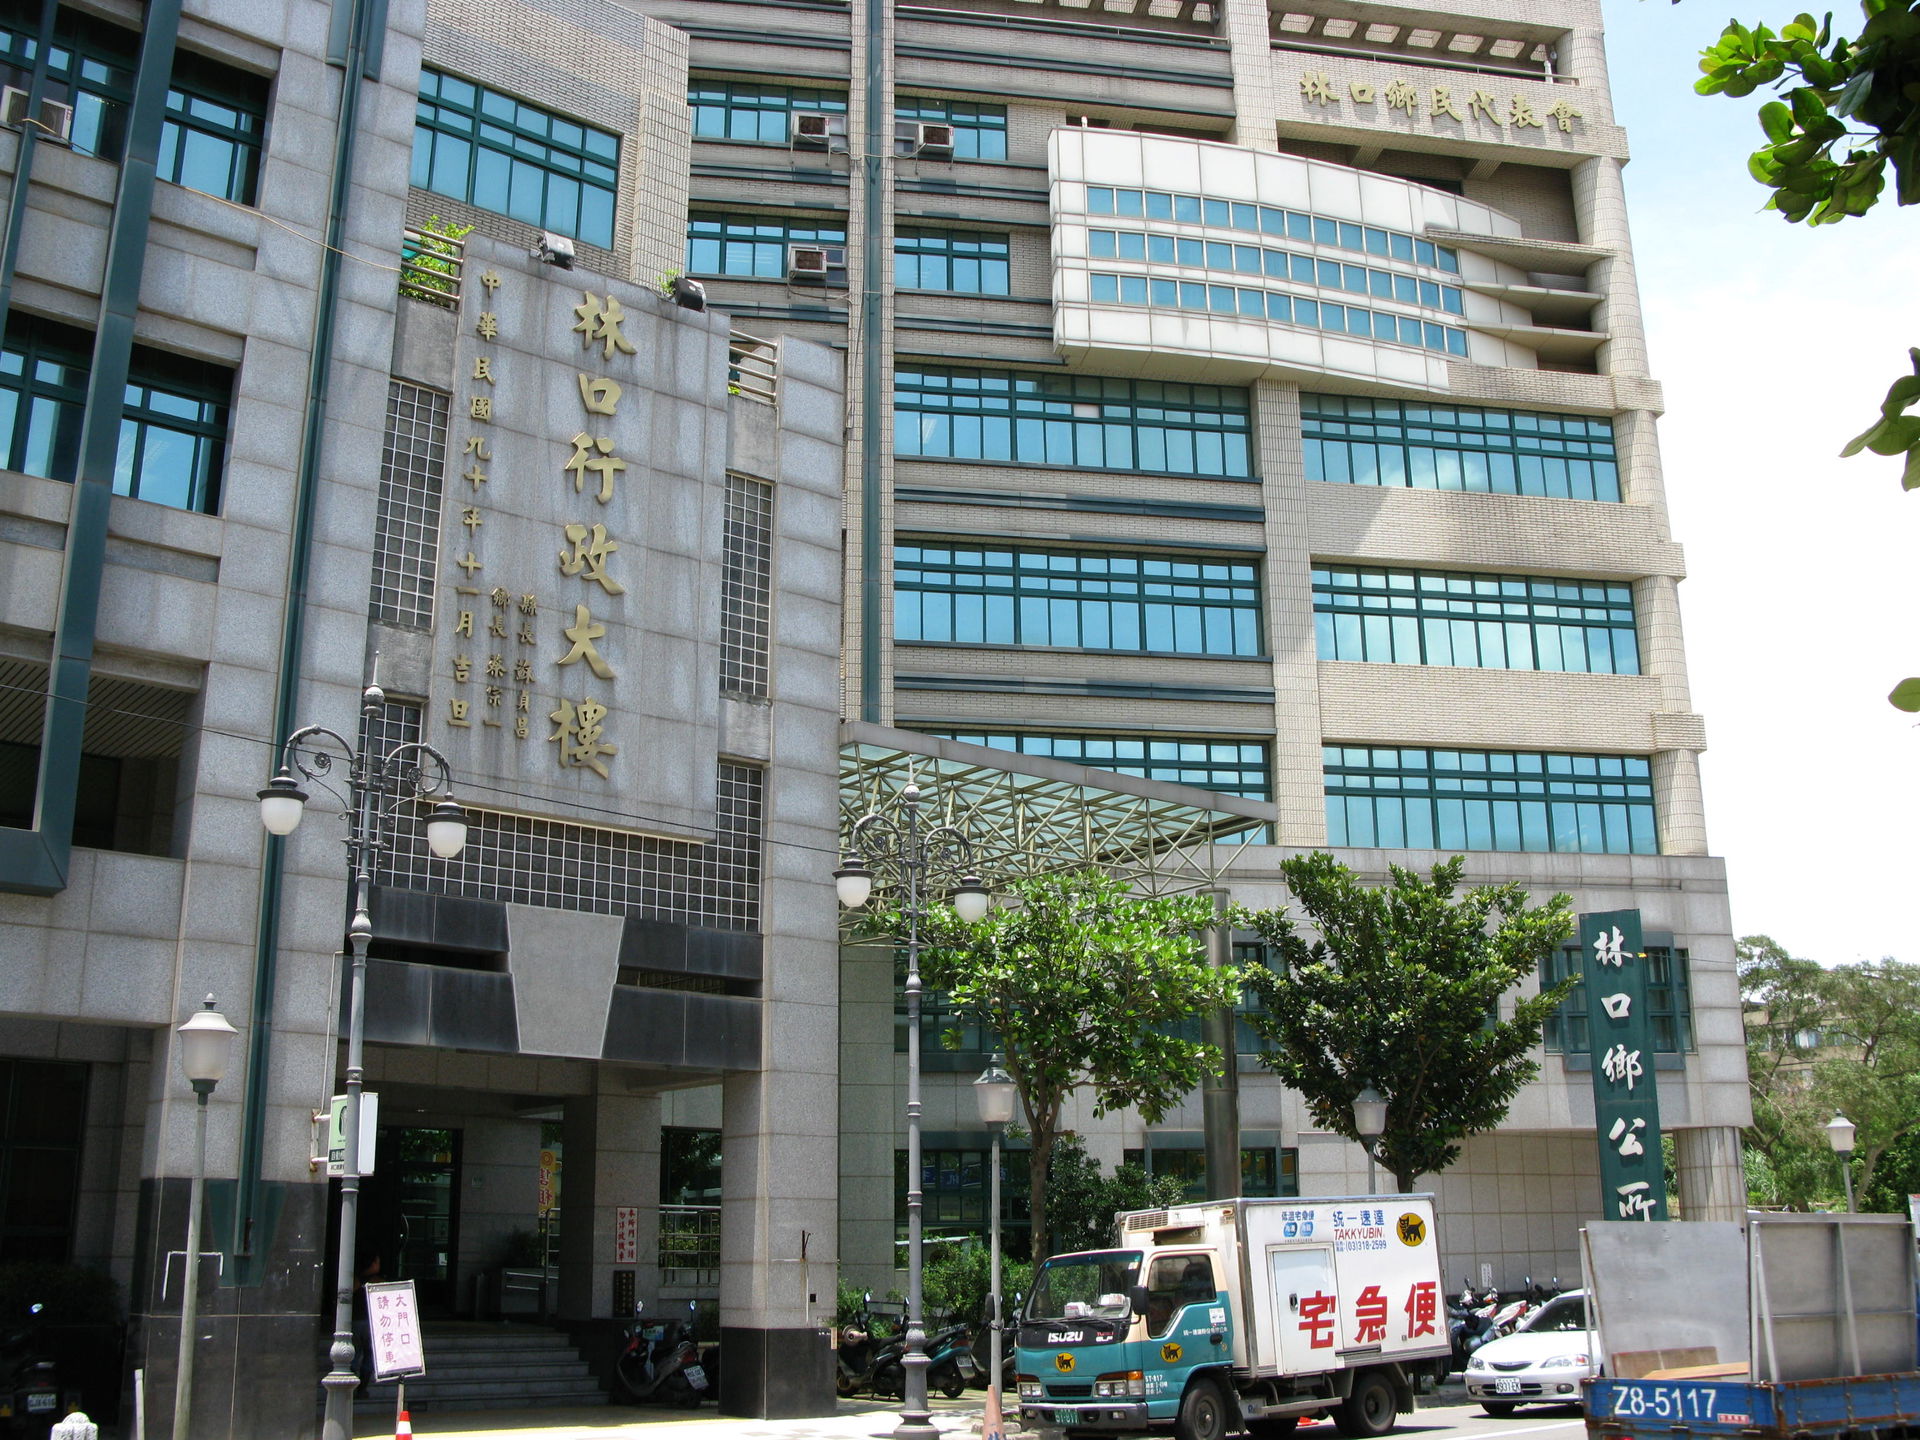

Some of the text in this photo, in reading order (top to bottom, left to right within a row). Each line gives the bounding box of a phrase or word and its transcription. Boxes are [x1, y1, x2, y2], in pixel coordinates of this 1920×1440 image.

[1300, 71, 1583, 133] 林口鄉民代表會
[549, 291, 637, 780] 林口行政大樓
[1593, 925, 1656, 1222] 林口鄉公所
[1334, 1226, 1384, 1241] TAKKYUBIN
[377, 1295, 396, 1363] 請勿停車
[395, 1294, 411, 1345] 大門口
[1047, 1330, 1084, 1343] ISUZU
[1299, 1281, 1437, 1349] 宅急便
[1612, 1385, 1717, 1419] Z8-5117
